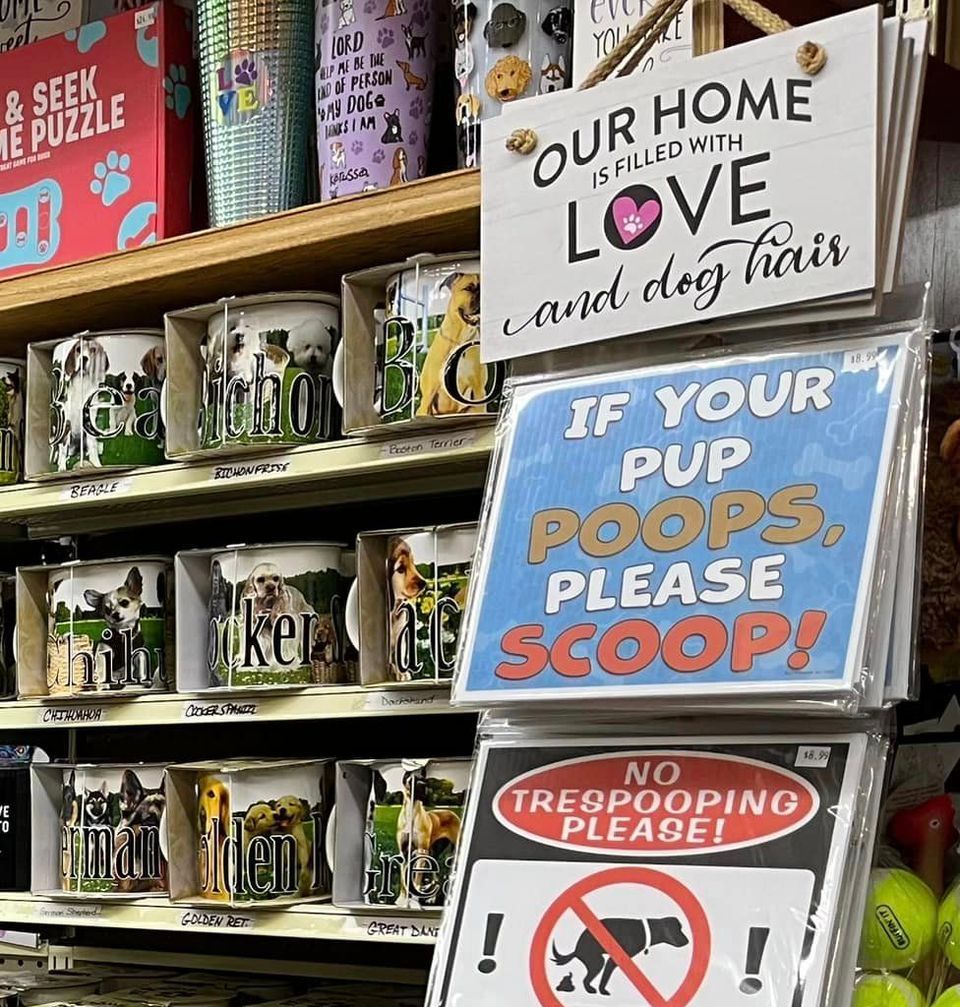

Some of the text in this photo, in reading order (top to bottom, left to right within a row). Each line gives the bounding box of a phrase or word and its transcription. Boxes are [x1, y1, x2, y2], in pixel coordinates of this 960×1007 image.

[332, 31, 364, 60] LORD
[338, 52, 385, 75] ME BE THE
[5, 89, 25, 126] &
[33, 65, 98, 117] SEEK
[335, 69, 392, 95] OF PERSON
[31, 93, 126, 153] PUZZLE
[326, 91, 375, 122] MY DOG
[360, 116, 376, 130] AM
[532, 76, 813, 188] OUR HOME
[593, 133, 742, 190] IS FILLED WITH
[568, 151, 772, 264] LOVE
[503, 220, 851, 337] and dog hair
[563, 367, 836, 441] IF YOUR
[619, 436, 753, 492] PUP
[70, 482, 120, 499] BEAGLE
[526, 484, 847, 565] POOPS,
[544, 553, 787, 615] PLEASE
[494, 610, 828, 681] SCOOP!
[623, 761, 681, 787] NO
[511, 789, 801, 817] TRESPOOPING
[560, 815, 725, 843] PLEASE!
[181, 912, 223, 927] GOLDEN
[368, 922, 406, 937] GREAT
